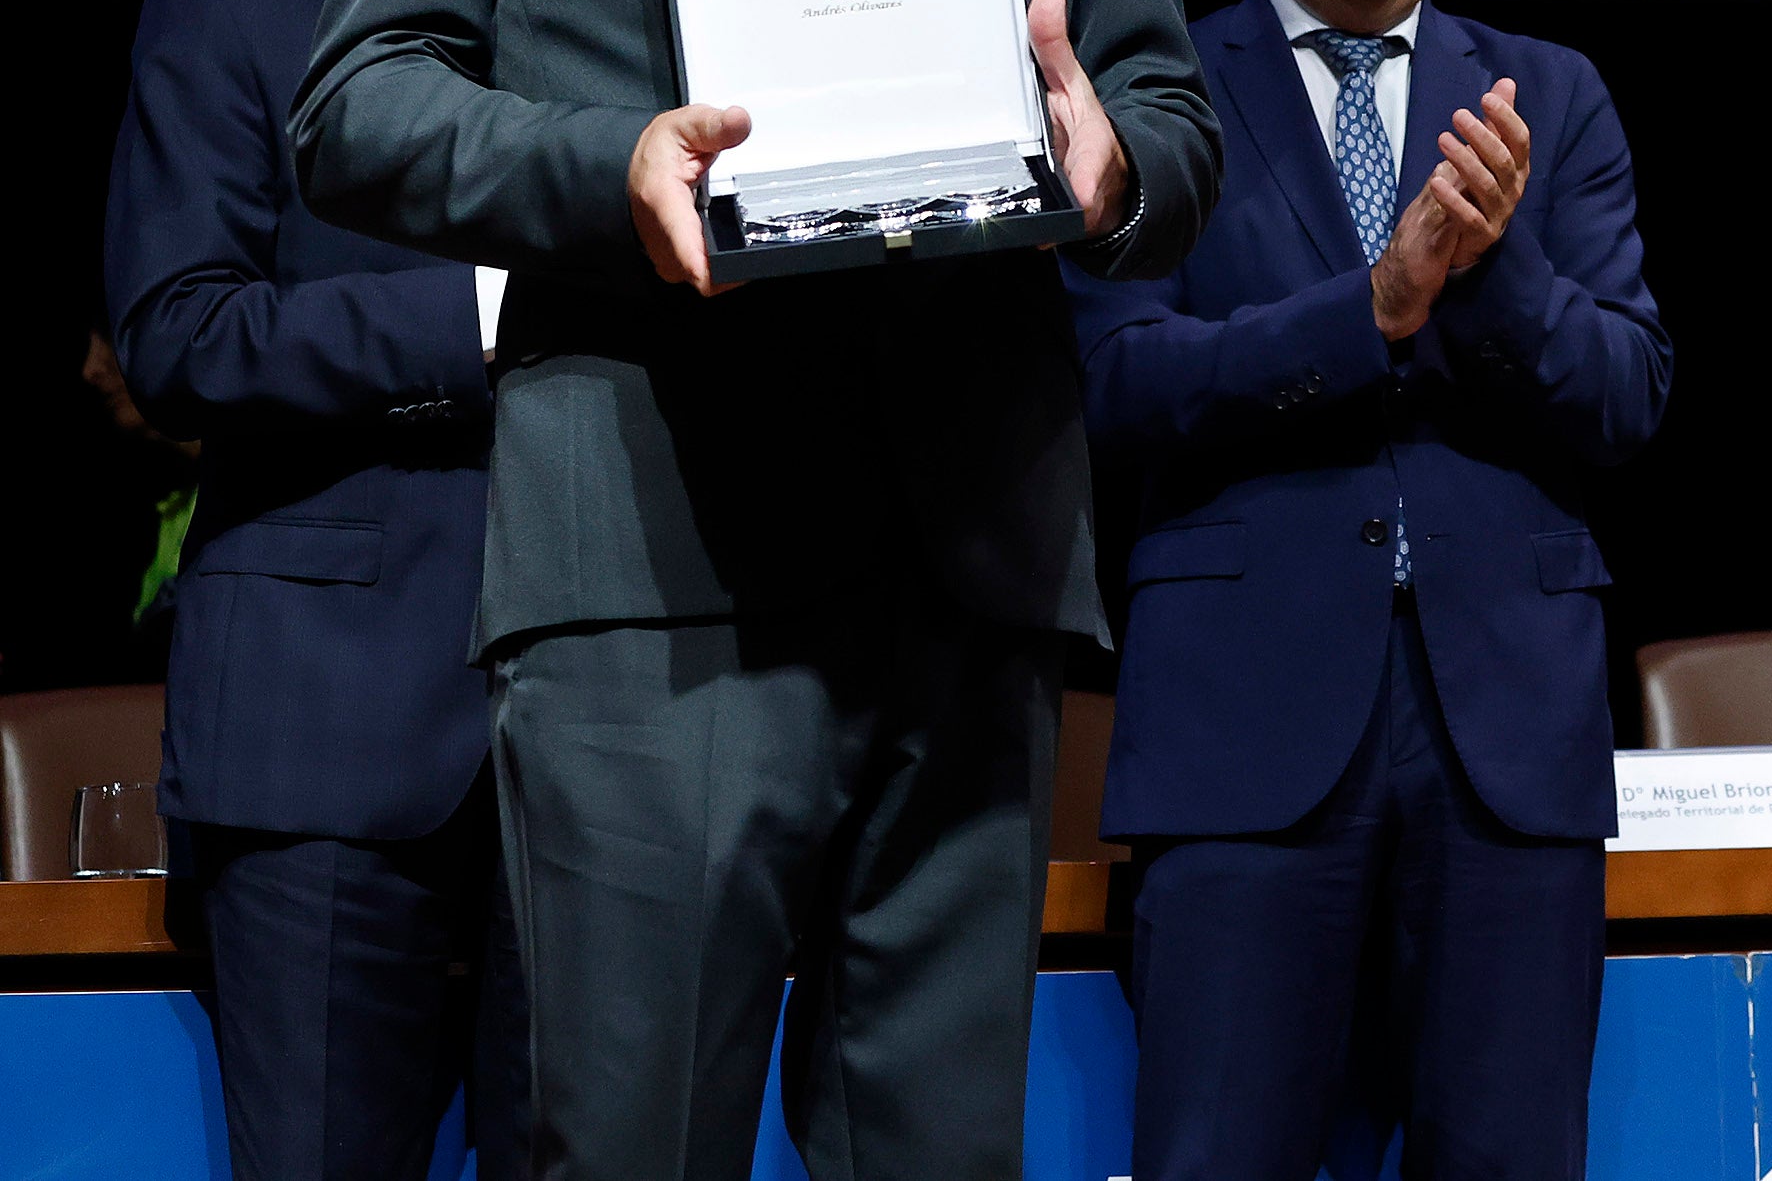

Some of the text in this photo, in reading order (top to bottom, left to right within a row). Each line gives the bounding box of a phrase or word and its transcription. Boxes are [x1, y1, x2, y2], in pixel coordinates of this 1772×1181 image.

[850, 0, 903, 13] Olivares
[1652, 783, 1718, 805] Miguel
[1619, 807, 1671, 821] elegado
[1674, 804, 1744, 818] Territorial
[1748, 804, 1765, 815] de
